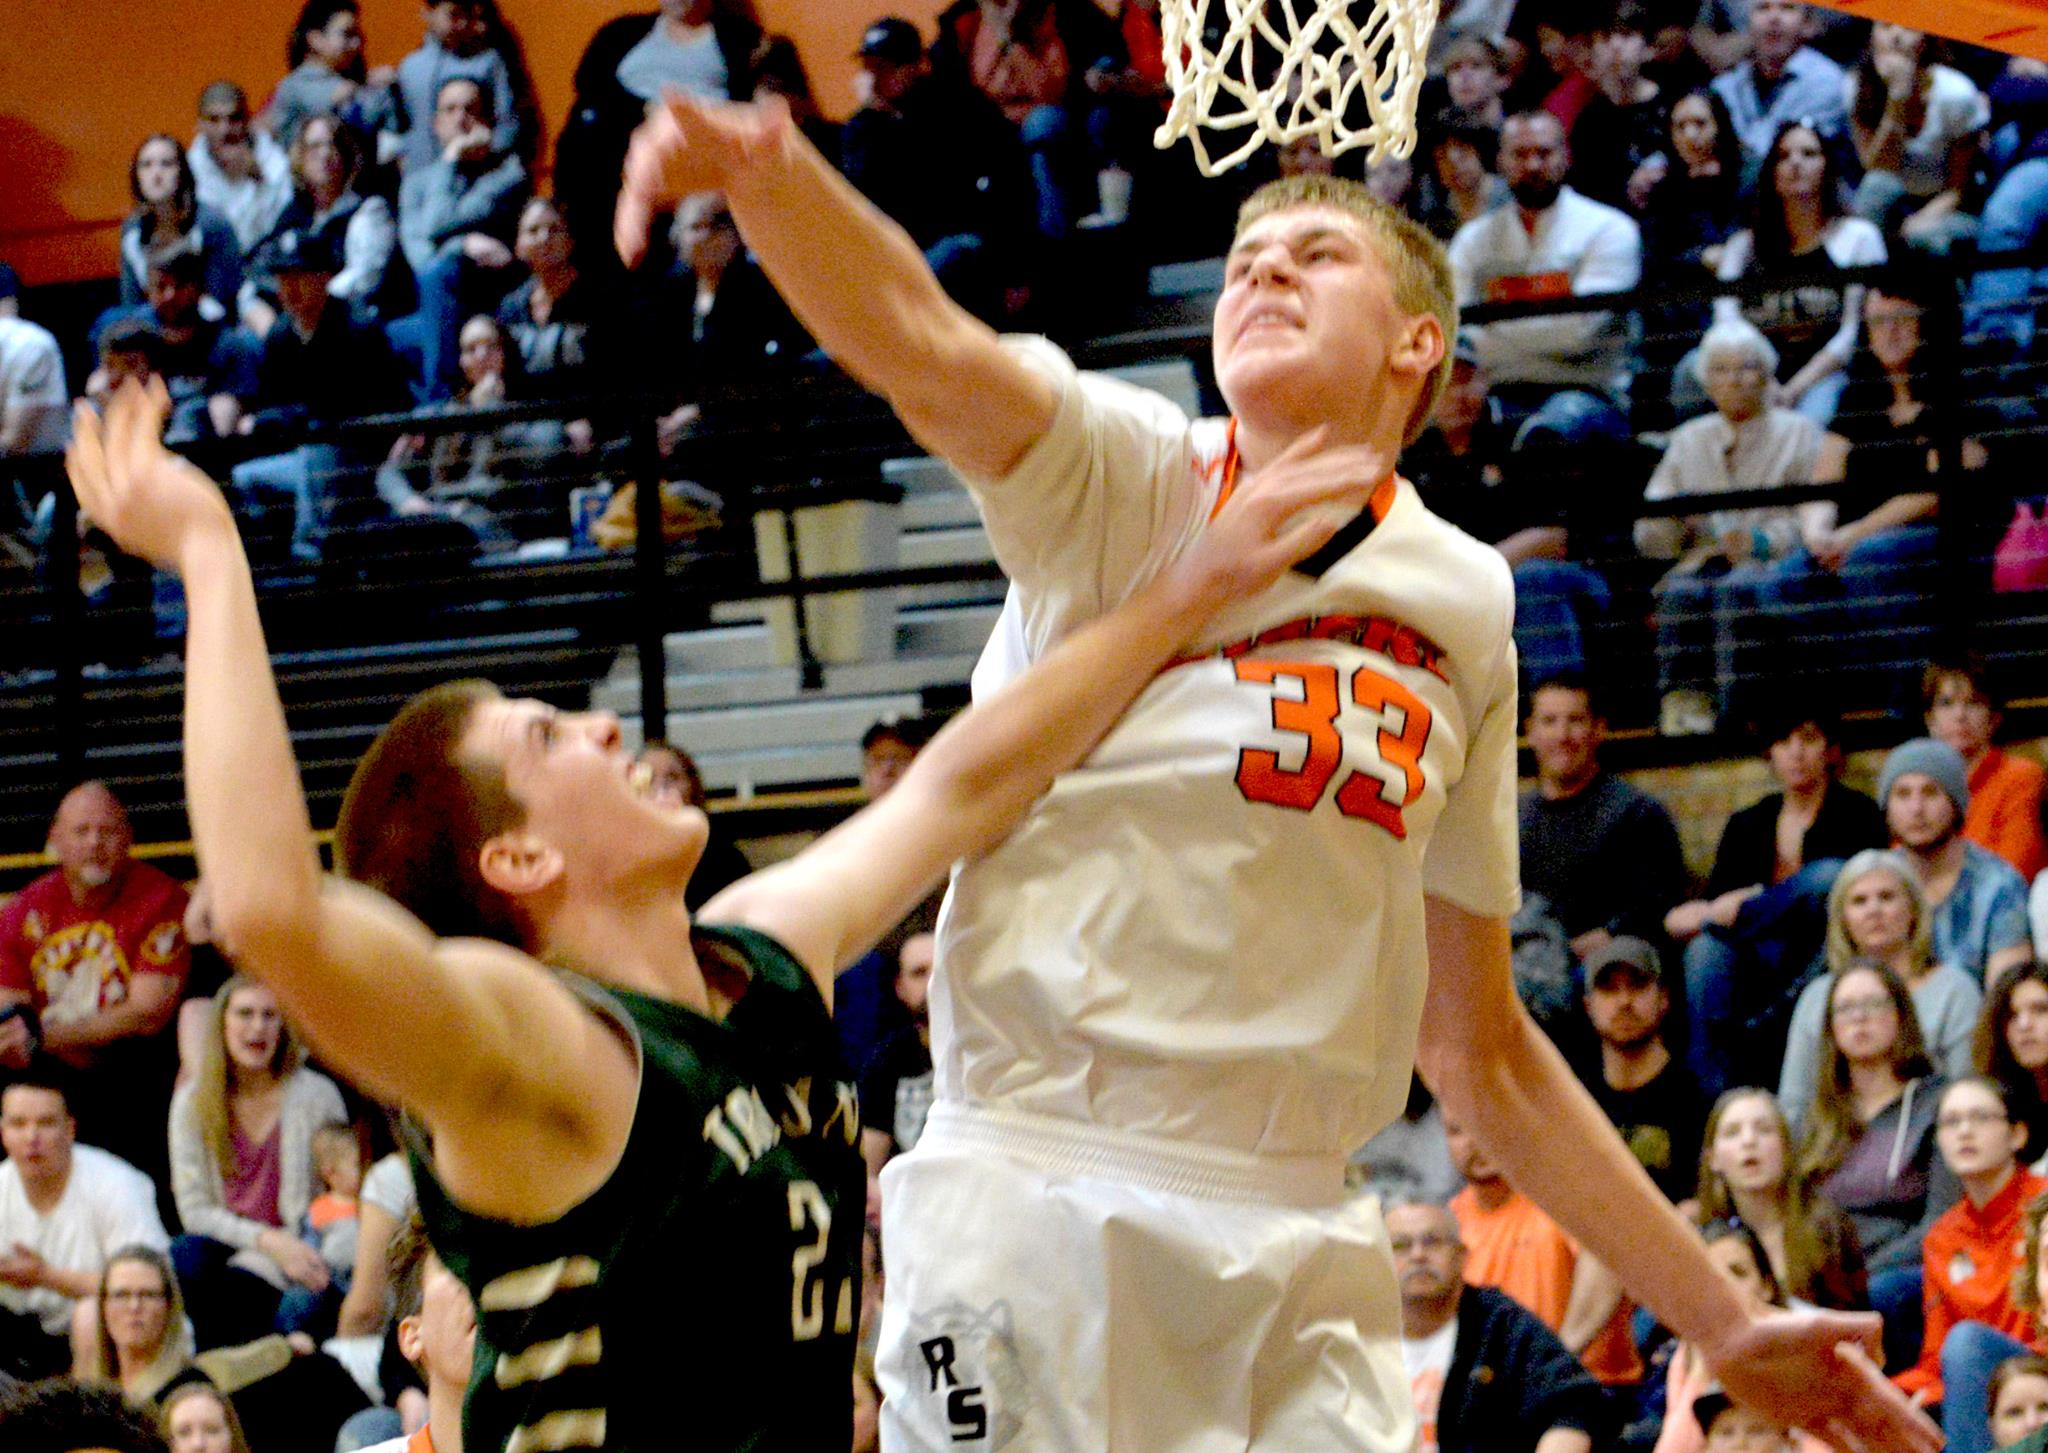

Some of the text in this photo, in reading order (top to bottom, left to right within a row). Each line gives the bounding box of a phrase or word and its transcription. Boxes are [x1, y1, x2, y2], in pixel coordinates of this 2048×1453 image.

[1234, 656, 1433, 841] 33
[919, 1335, 959, 1393] R
[947, 1386, 987, 1442] S
